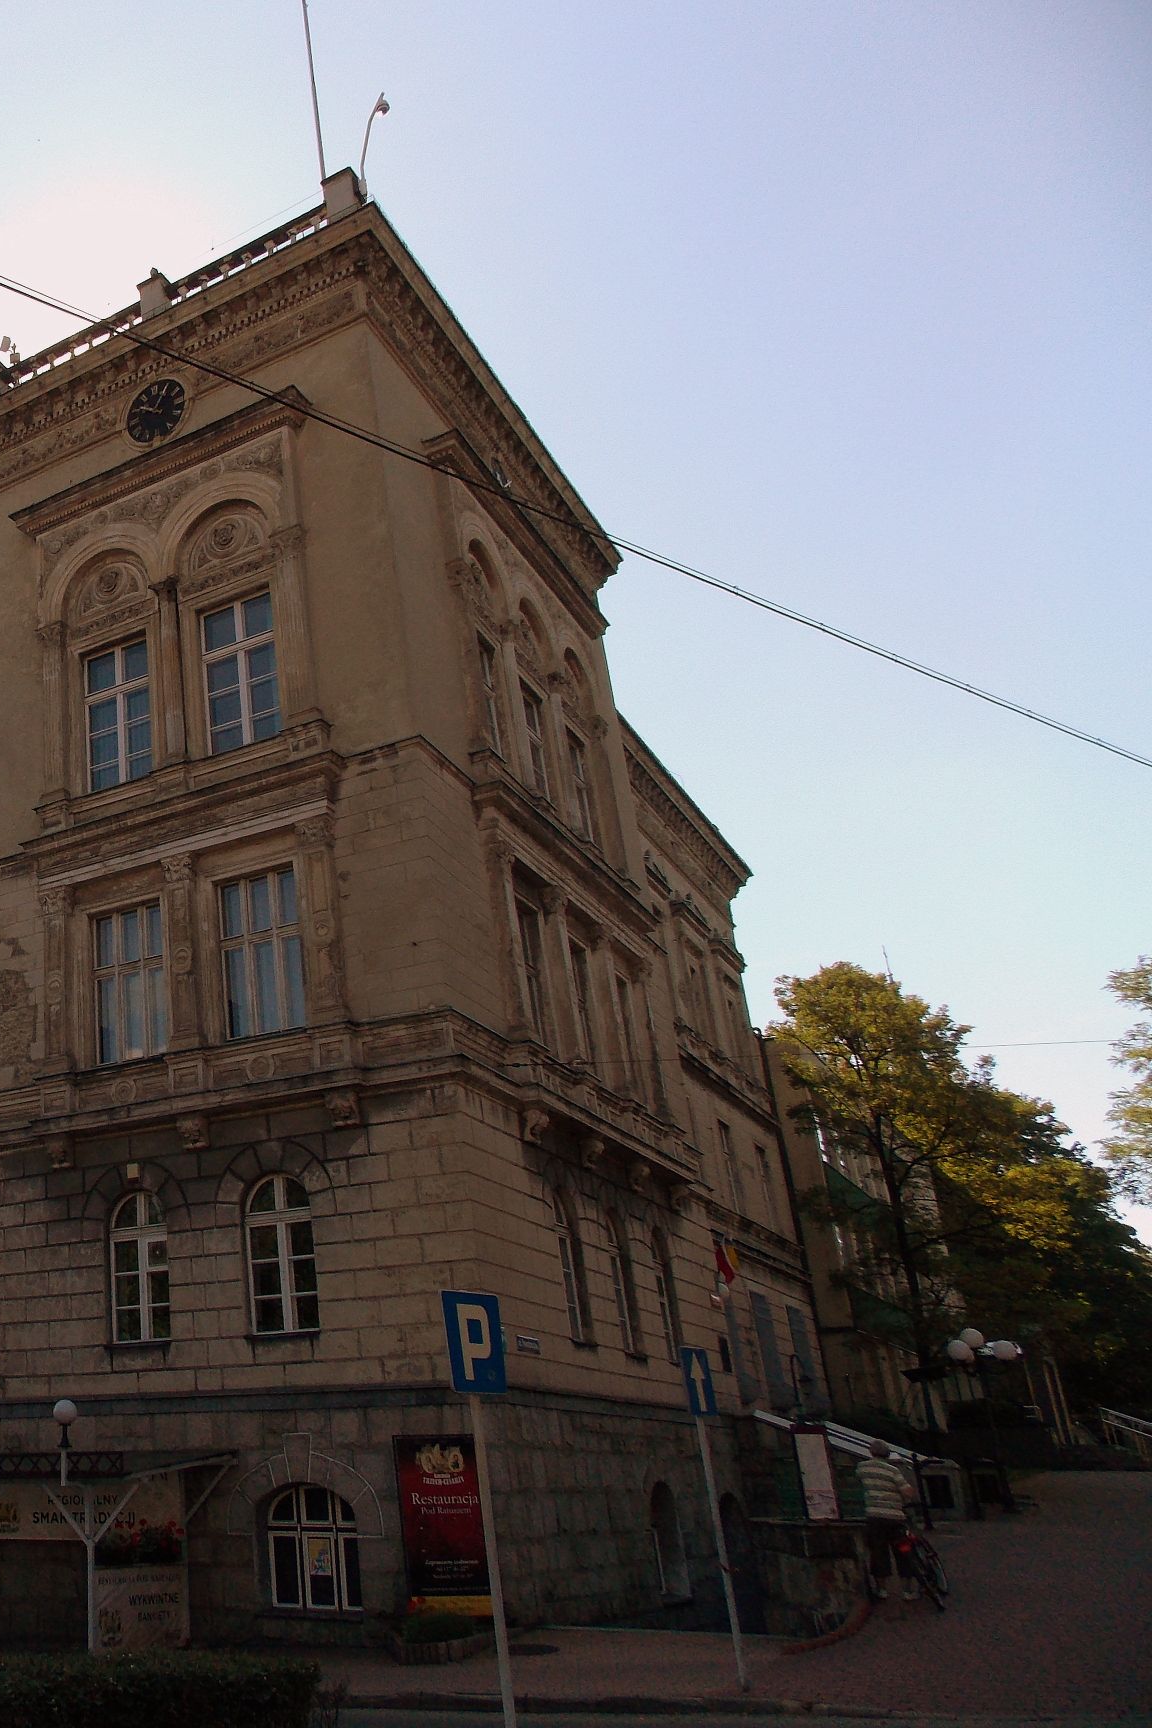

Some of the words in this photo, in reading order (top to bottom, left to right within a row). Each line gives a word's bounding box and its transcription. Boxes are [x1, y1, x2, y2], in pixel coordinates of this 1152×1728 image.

[455, 1303, 492, 1381] P
[47, 1495, 118, 1505] RGIOLNY
[411, 1492, 479, 1506] Restauracja
[421, 1506, 436, 1515] Pod
[71, 1511, 136, 1526] TRDCJI
